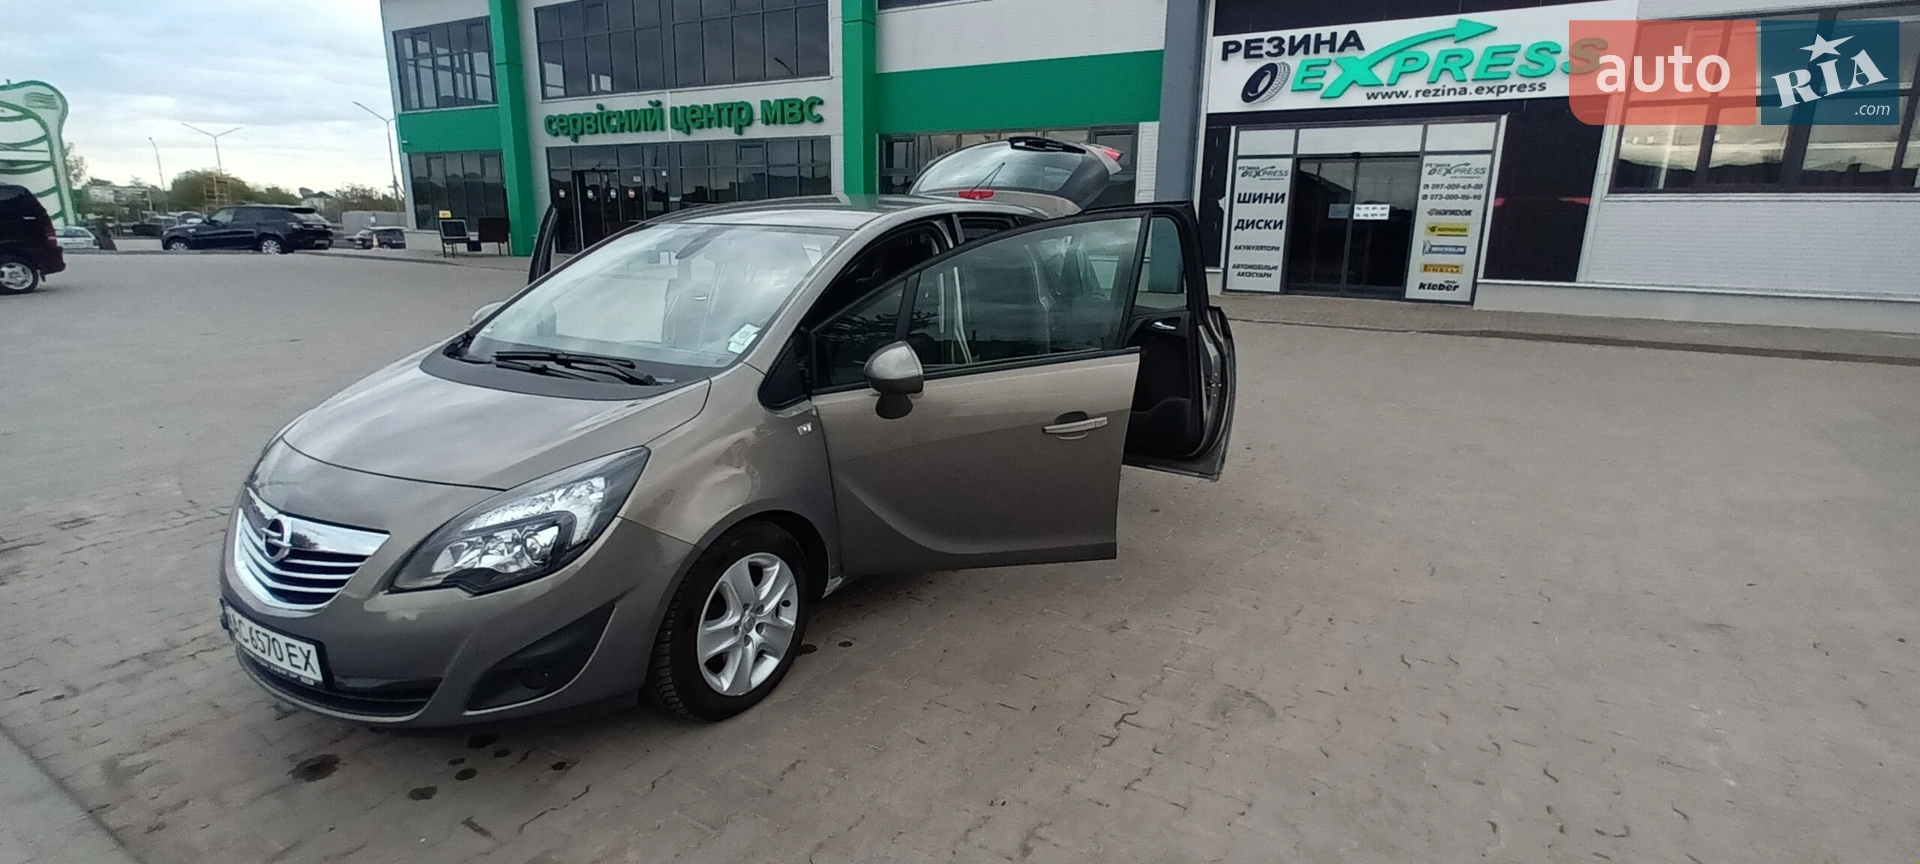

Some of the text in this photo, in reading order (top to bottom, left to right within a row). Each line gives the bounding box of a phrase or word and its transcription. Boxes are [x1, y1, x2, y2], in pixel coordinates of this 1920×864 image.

[1221, 30, 1365, 61] РЕЗИНА
[1291, 37, 1609, 99] EXPRESS
[1366, 81, 1547, 102] www.rezina.express
[544, 96, 824, 143] сервісний центр МВС
[1436, 166, 1487, 177] EXPRESS
[1236, 192, 1286, 204] ШИНИ
[1233, 218, 1284, 231] ДИСКИ
[248, 626, 284, 663] 6570
[285, 642, 318, 676] EX
